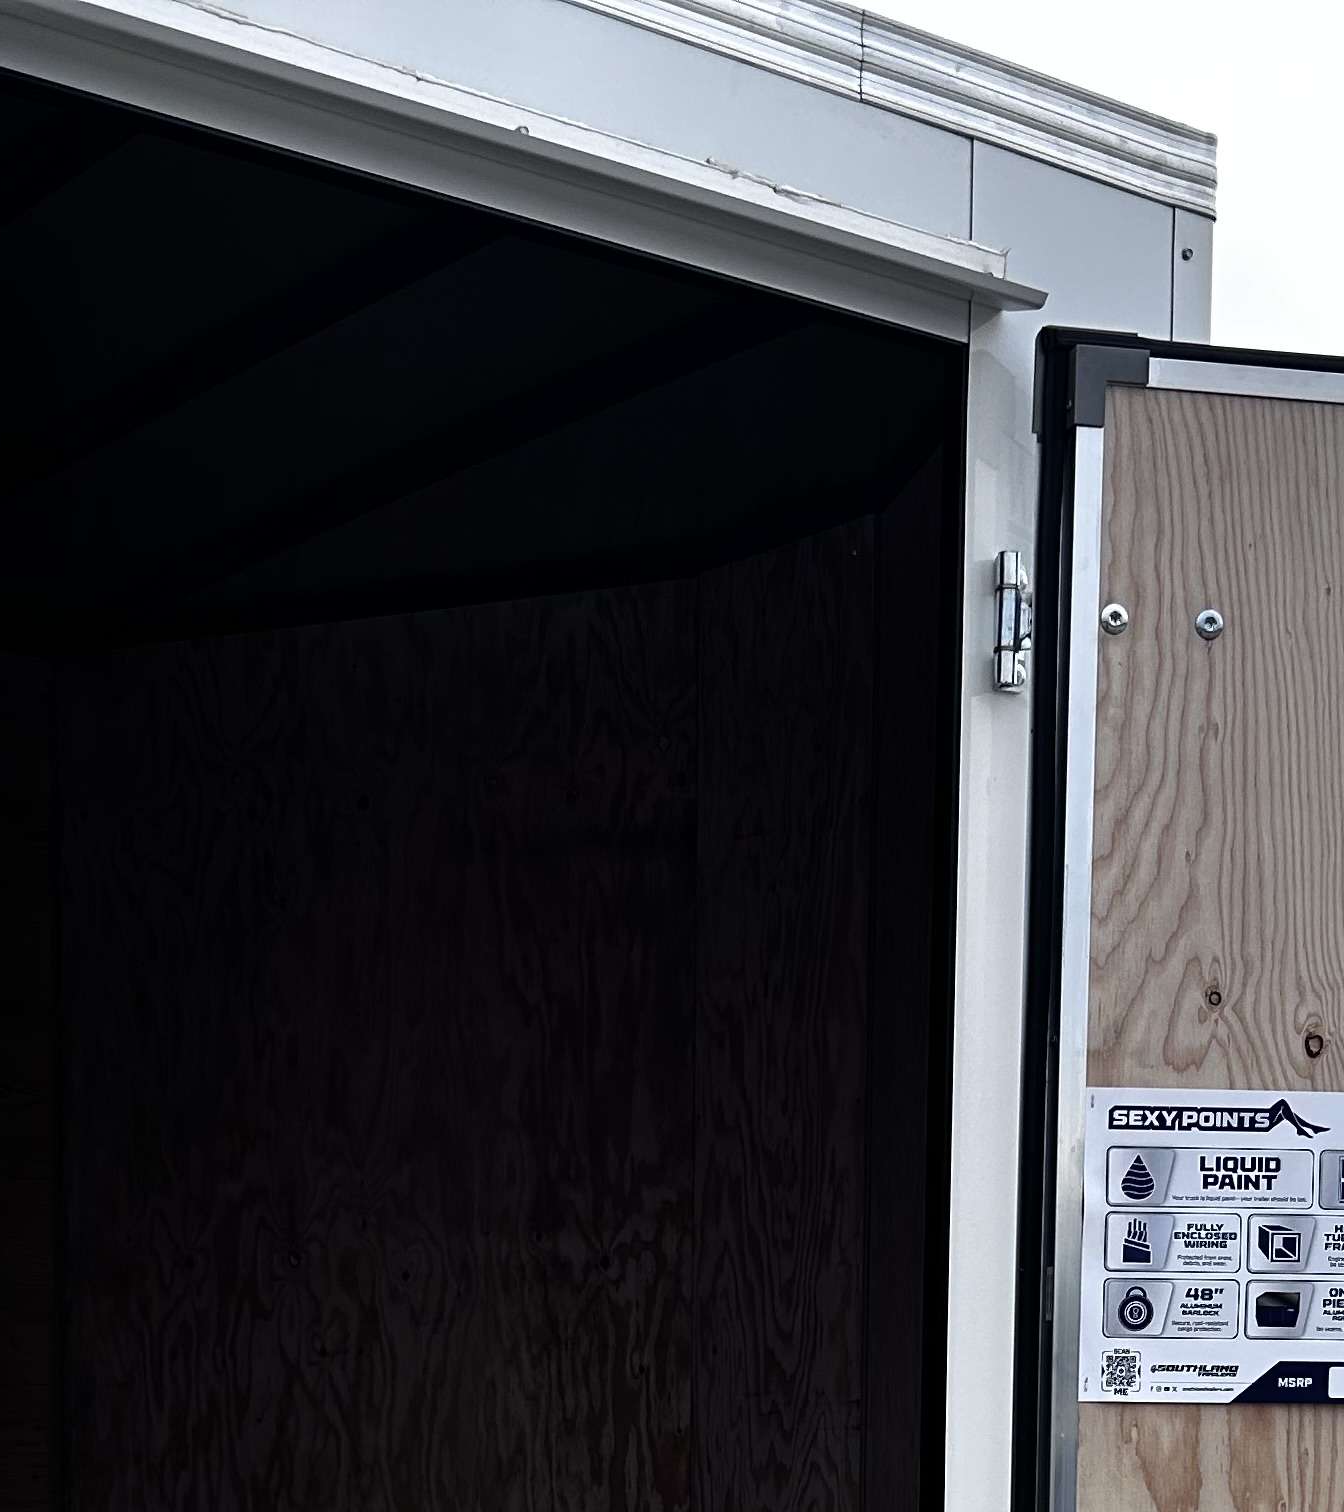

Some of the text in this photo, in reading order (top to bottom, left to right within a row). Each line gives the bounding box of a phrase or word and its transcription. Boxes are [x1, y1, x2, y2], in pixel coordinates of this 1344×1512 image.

[1112, 1110, 1270, 1128] SEXY POINTS
[1199, 1156, 1281, 1173] LIQUID
[1202, 1175, 1278, 1190] PAINT
[1186, 1223, 1224, 1232] FULLY
[1174, 1232, 1237, 1240] ENCLOSED
[1184, 1241, 1228, 1249] WIRING
[1157, 1364, 1239, 1372] SOUTHLAND
[1278, 1377, 1313, 1388] MSRP
